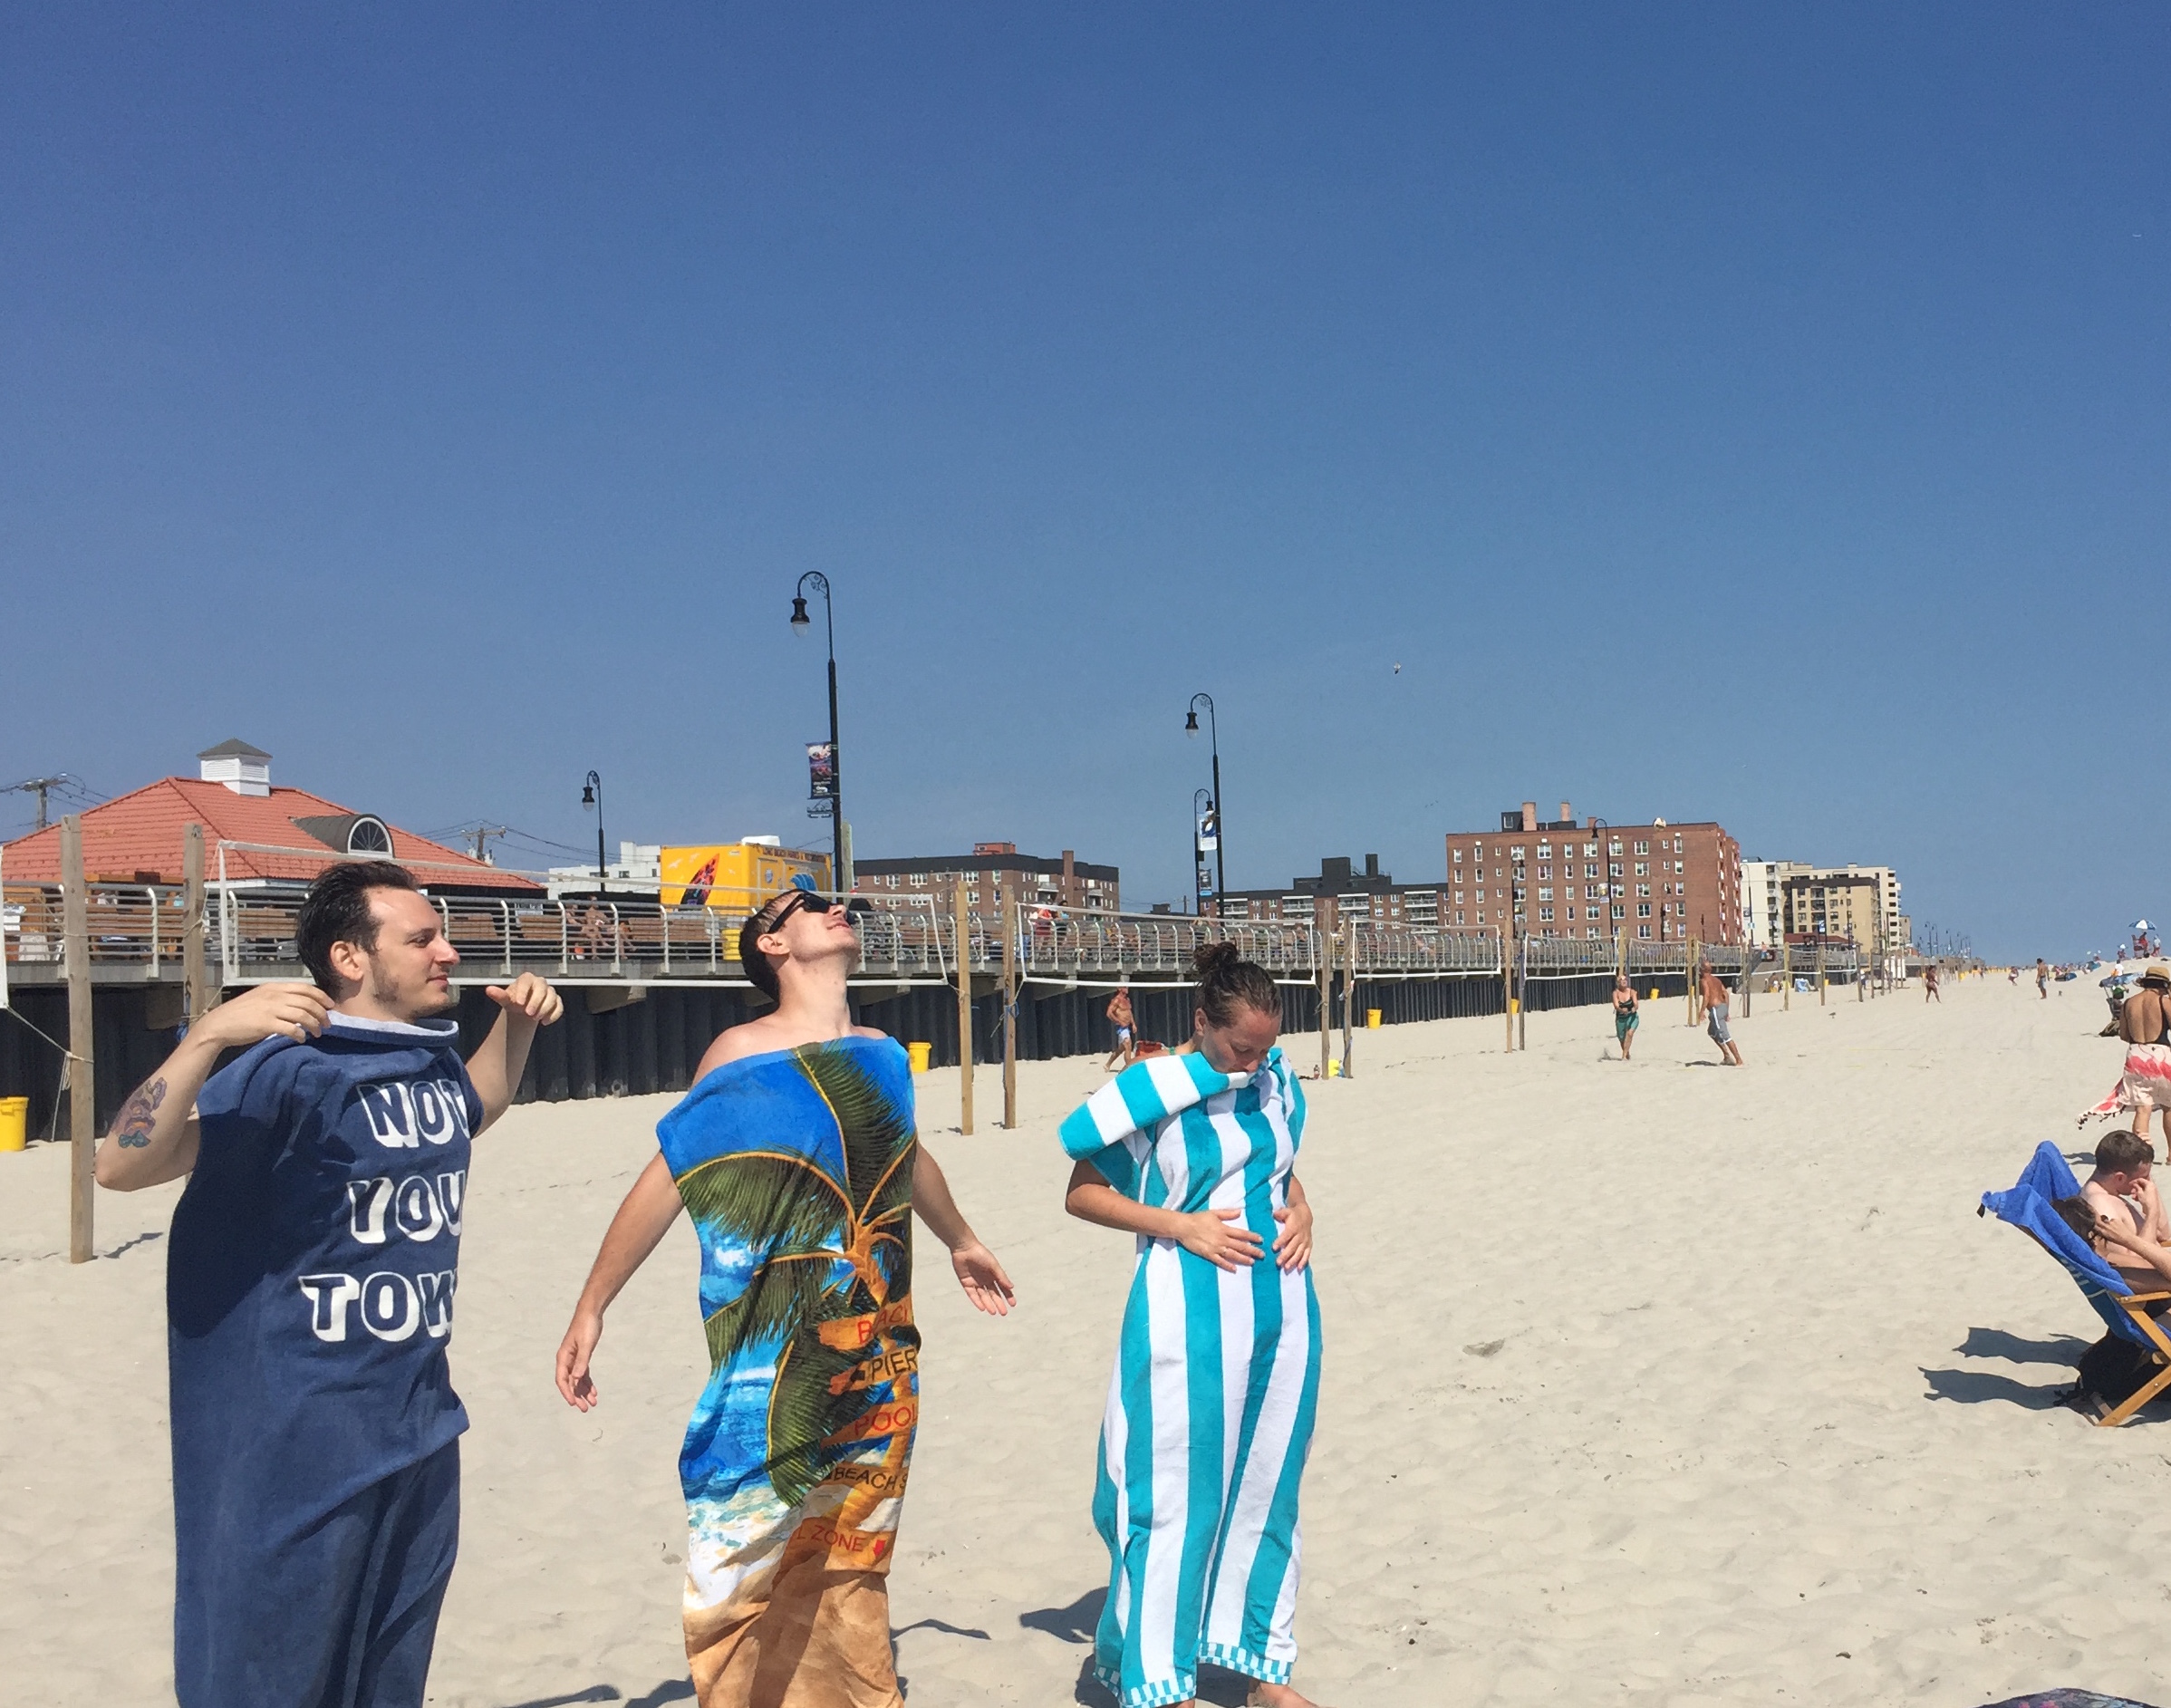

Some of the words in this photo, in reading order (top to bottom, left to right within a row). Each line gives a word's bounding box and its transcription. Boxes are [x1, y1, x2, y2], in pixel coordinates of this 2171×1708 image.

[871, 1348, 917, 1381] PIER
[854, 1404, 917, 1436] POOL
[834, 1467, 897, 1491] BEACH
[811, 1524, 868, 1552] ZONE
